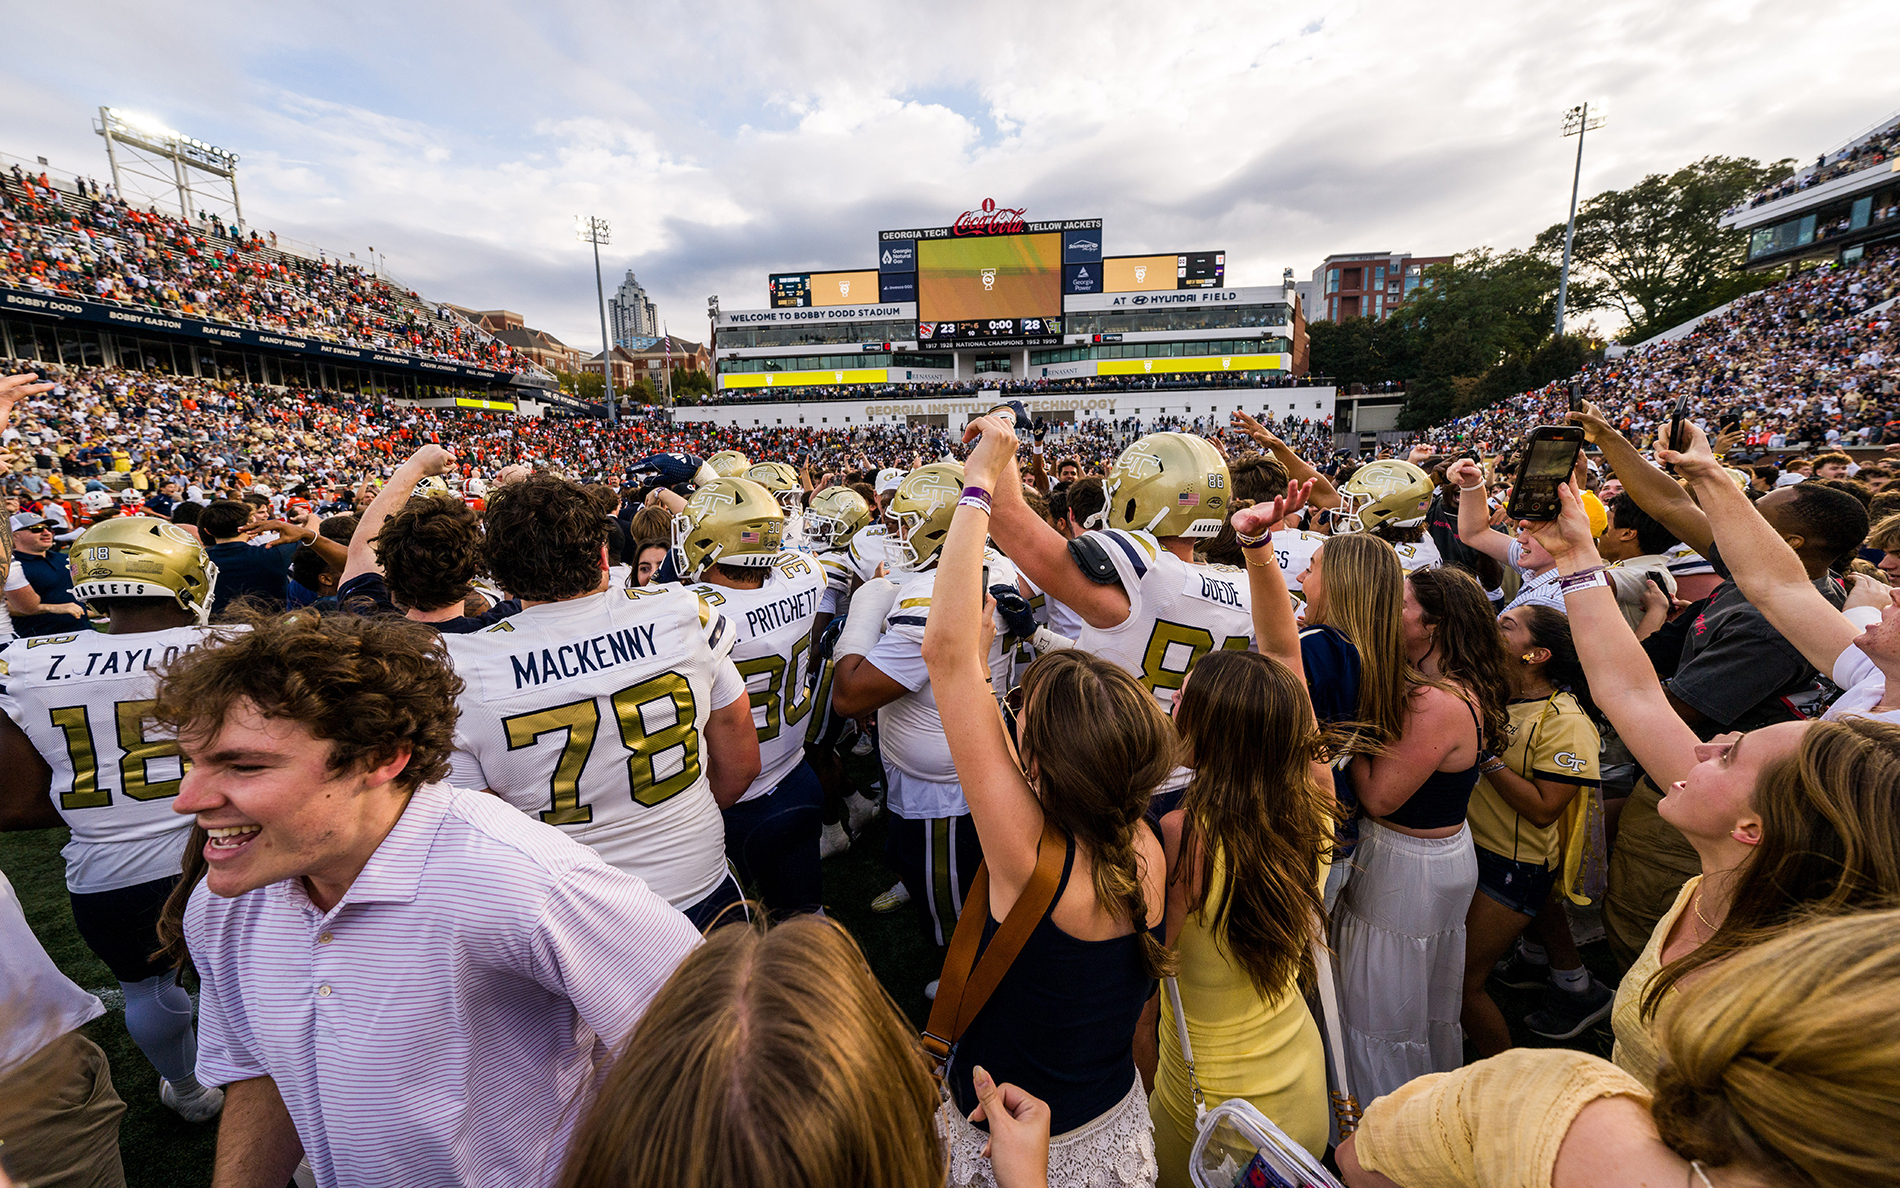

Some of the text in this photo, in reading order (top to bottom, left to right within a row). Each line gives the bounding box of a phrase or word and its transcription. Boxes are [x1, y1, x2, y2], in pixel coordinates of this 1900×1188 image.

[953, 207, 1028, 236] Coca-Cola
[1028, 220, 1101, 231] YELLOW JACKETS
[882, 228, 948, 240] GEORGIA TECH
[6, 294, 83, 313] BOBBY DODD
[1113, 292, 1236, 305] AT HYUNDAI FIELD
[109, 311, 182, 329] BOBBY GASTON
[730, 308, 900, 322] WELCOME TO BOBBY DODD STADIUM
[202, 326, 242, 338] RAY BECK
[940, 323, 956, 334] 23
[988, 320, 1013, 330] 0:00
[1024, 320, 1040, 330] 28
[259, 335, 306, 348] RANDY RHINO
[320, 345, 360, 357] PAT SWILLING
[384, 356, 409, 365] HAMILTON
[420, 362, 458, 372] CALVIN JOHNSON
[476, 370, 495, 378] JOHNSON
[912, 372, 943, 380] RENASANT
[1048, 367, 1078, 376] RENASANT
[865, 404, 924, 416] GEORGIA
[1027, 398, 1118, 411] TECHNOLOGY
[711, 457, 736, 474] GT
[1116, 440, 1162, 479] GT
[748, 467, 778, 484] GT
[1208, 472, 1224, 489] 86
[1361, 467, 1410, 495] GT
[906, 475, 960, 509] GT
[768, 521, 780, 534] 30
[88, 546, 110, 561] 18
[74, 584, 145, 598] JACKETS
[1198, 573, 1243, 607] GOEDE
[746, 586, 817, 637] PRITCHETT
[510, 622, 659, 689] MACKENNY
[46, 654, 71, 680] Z.
[735, 633, 812, 742] 30
[49, 697, 192, 811] 18
[501, 670, 702, 826] 78
[1553, 751, 1587, 773] GT
